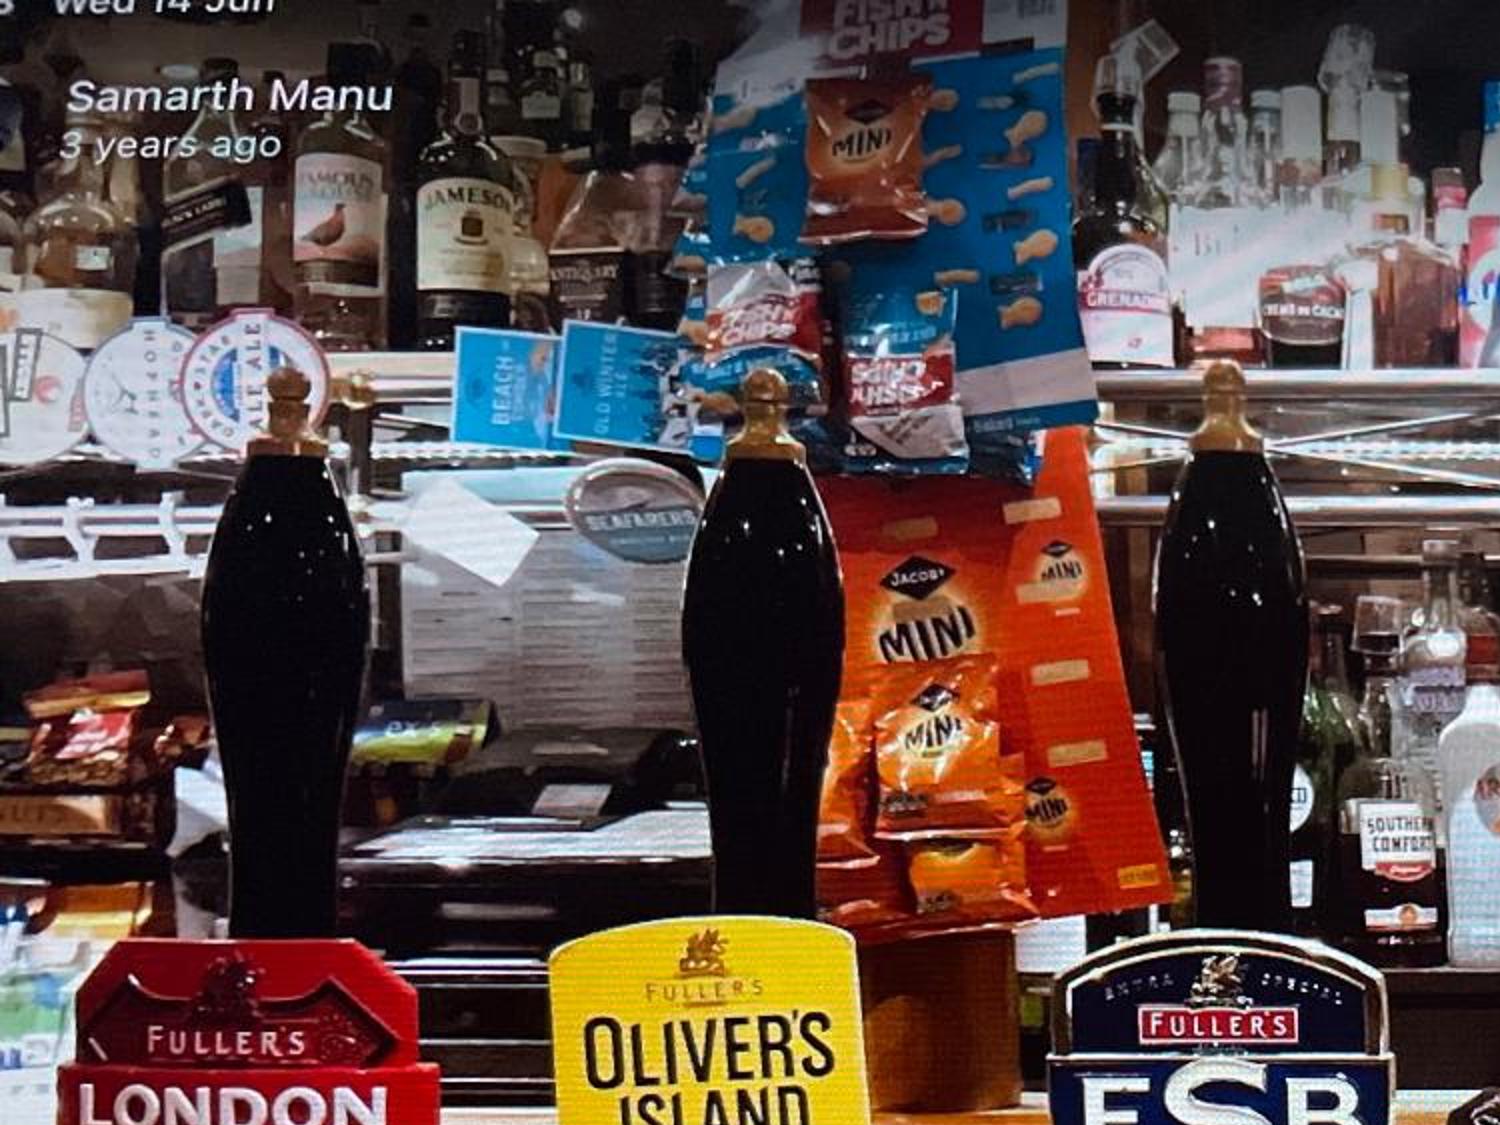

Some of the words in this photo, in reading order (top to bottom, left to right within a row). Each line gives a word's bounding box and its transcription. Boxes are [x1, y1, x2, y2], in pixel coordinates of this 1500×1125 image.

[827, 13, 950, 58] CHIPS
[832, 127, 892, 157] MINI
[491, 356, 514, 426] BEACH
[878, 605, 977, 664] MINI
[905, 714, 964, 750] MINI
[1372, 835, 1435, 855] COMFORT
[1150, 1011, 1288, 1039] FULLER'S
[583, 1010, 836, 1091] OLIVER'S
